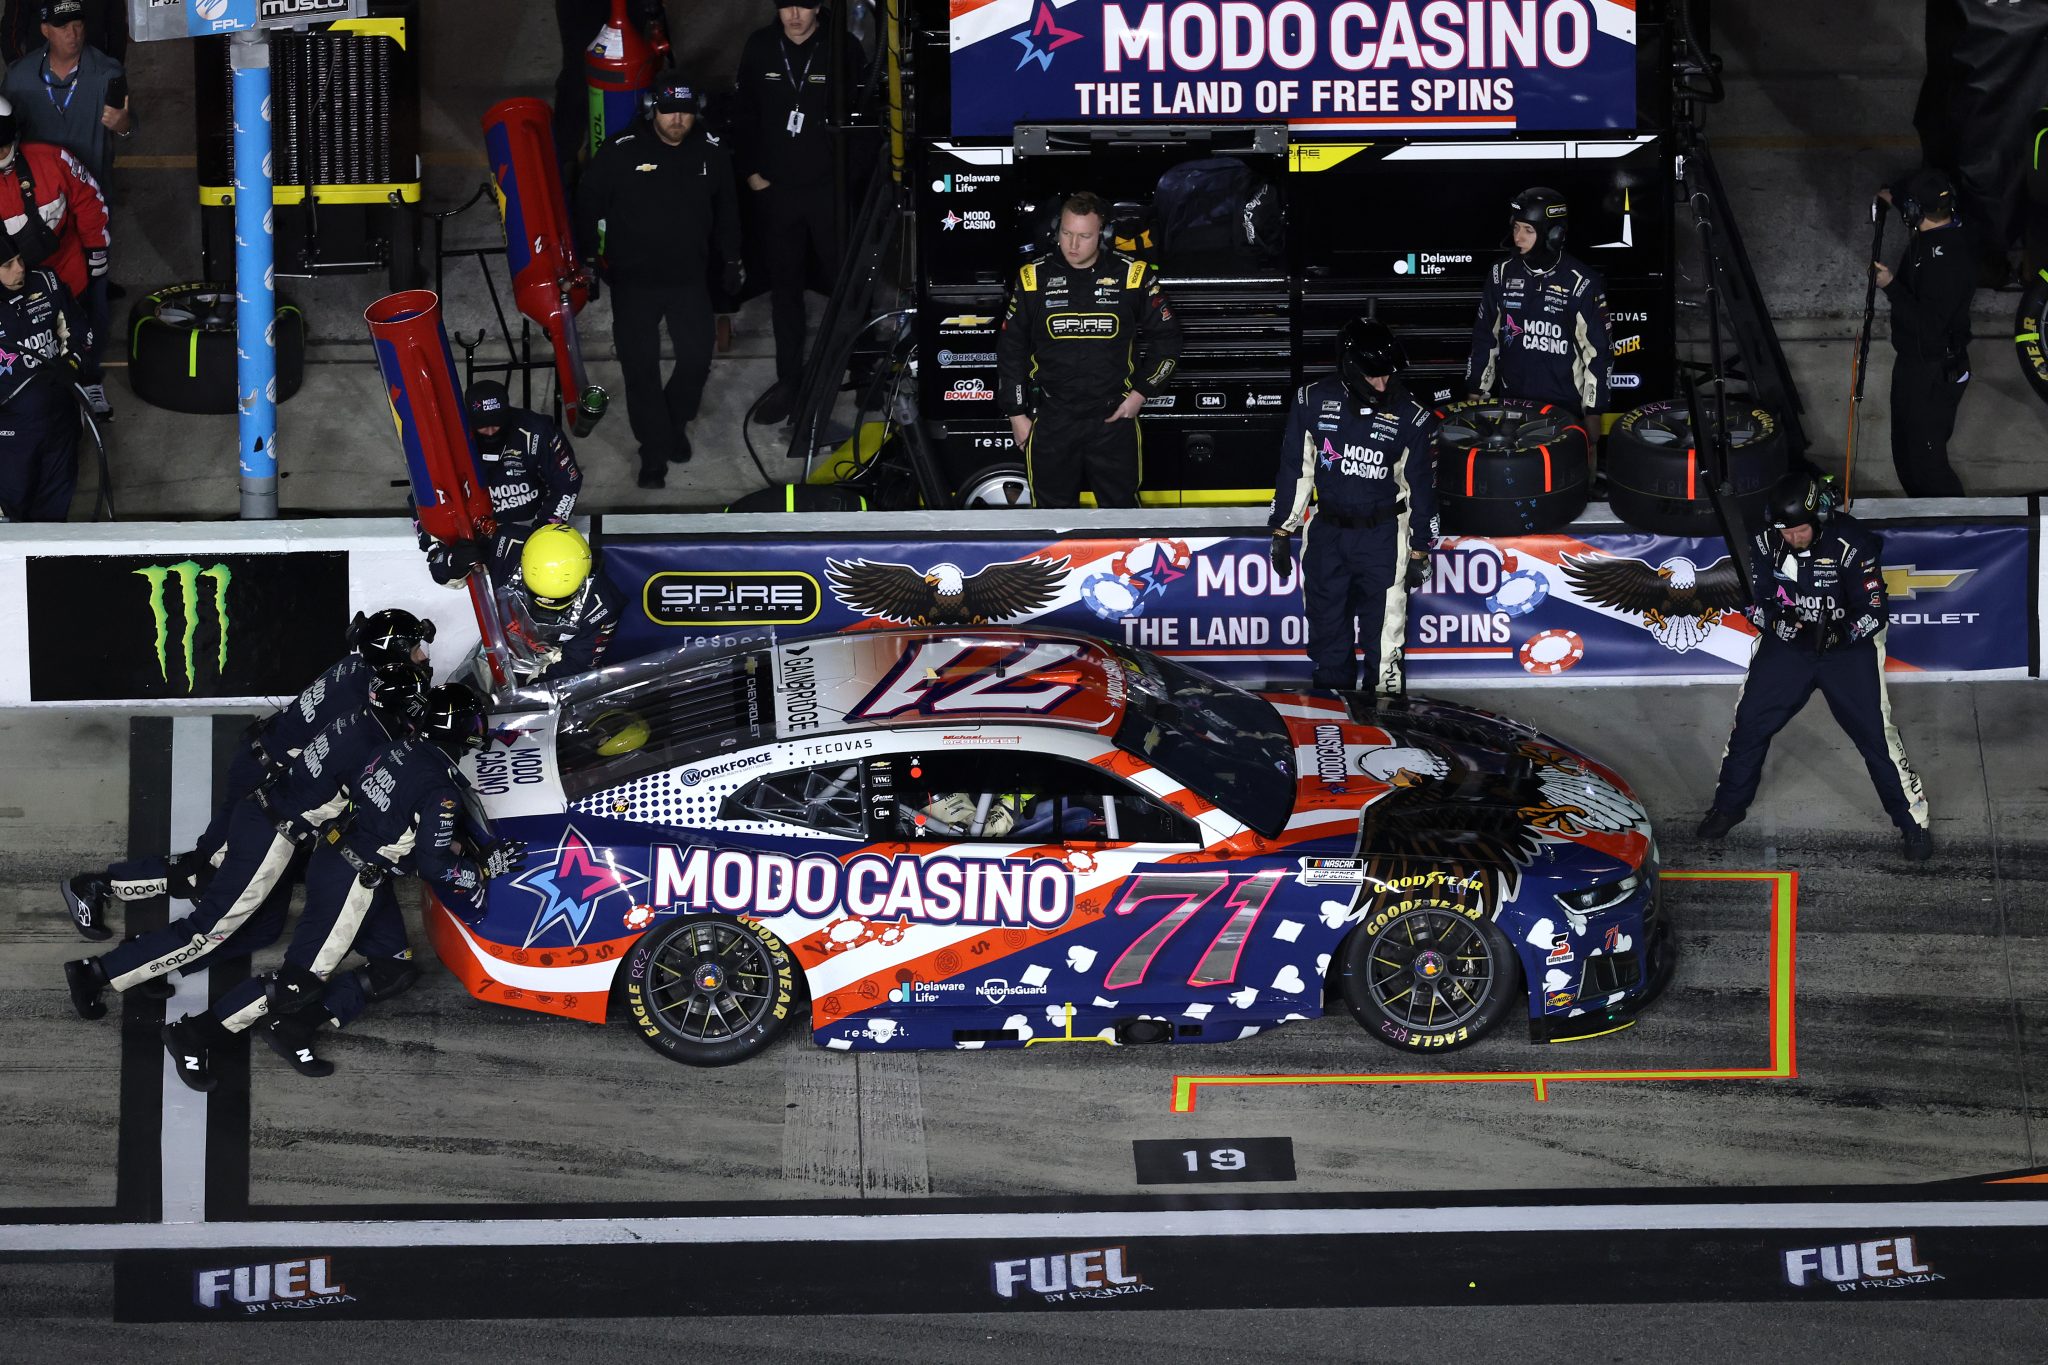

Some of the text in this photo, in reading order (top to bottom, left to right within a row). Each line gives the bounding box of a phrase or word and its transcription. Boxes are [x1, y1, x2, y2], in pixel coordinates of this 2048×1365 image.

[212, 19, 245, 31] FPL
[1103, 0, 1592, 72] MODO CASINO
[1075, 77, 1514, 115] THE LAND OF FREE SPINS
[1288, 149, 1320, 157] PIRE
[955, 173, 1001, 183] Delaware
[963, 211, 991, 220] MODO
[963, 220, 996, 230] CASINO
[1420, 253, 1473, 263] Delaware
[1052, 318, 1113, 331] SPIRE
[1609, 312, 1648, 322] COVAS
[1523, 318, 1562, 339] MODO
[1522, 334, 1569, 356] CASINO
[1613, 334, 1641, 357] STER
[955, 381, 975, 391] GO
[1611, 376, 1637, 386] UNK
[945, 391, 993, 400] BOWLING
[1201, 396, 1221, 406] SEM
[1433, 388, 1451, 399] WIX
[1446, 397, 1499, 412] EAGLE
[1620, 408, 1644, 432] EAGLE
[974, 436, 1014, 450] resp
[1343, 443, 1384, 466] MODO
[1340, 458, 1389, 480] CASINO
[488, 482, 530, 500] MODO
[491, 488, 539, 514] CASINO
[553, 494, 572, 518] MODO
[561, 493, 578, 521] CASINO
[1197, 553, 1304, 597] MOD
[661, 582, 803, 605] SPIRE
[588, 608, 609, 625] sparco
[661, 605, 803, 613] MOTORSPORTS
[1889, 612, 1980, 625] ROLET
[1120, 617, 1164, 646] THE
[1189, 615, 1260, 646] LAND
[1418, 612, 1511, 644] SPINS
[683, 630, 778, 649] respt
[783, 657, 819, 733] GAINBRIDGE
[745, 677, 761, 739] CHEVROLET
[804, 738, 874, 757] TECOVAS
[475, 749, 510, 796] CASINO
[509, 747, 545, 785] MODO
[686, 751, 773, 783] WORKFORCE
[372, 765, 397, 795] MODO
[360, 776, 391, 813] CASINO
[878, 809, 890, 817] SEM
[1324, 859, 1356, 868] NASCAR
[655, 846, 1068, 926] MODO CASINO
[1373, 870, 1484, 894] GOODYEAR
[1366, 898, 1484, 936] GOODYEAR
[1104, 868, 1288, 990] 71
[1604, 923, 1619, 951] 71
[149, 934, 210, 974] modo.us
[631, 948, 651, 980] RR-2
[737, 915, 794, 1021] GOODYEAR
[915, 981, 966, 992] Delaware
[915, 992, 936, 1003] Life
[975, 984, 1048, 997] NationsGuard
[628, 983, 661, 1038] EAGLE
[844, 1025, 910, 1040] respect.
[1380, 1020, 1409, 1042] RF-2
[1408, 1026, 1469, 1047] EAGLE
[1182, 1148, 1247, 1173] 19
[994, 1246, 1138, 1298] FUEL
[1785, 1236, 1929, 1287] FUEL
[199, 1256, 342, 1308] FUEL
[1044, 1283, 1155, 1303] BY FRANZIA
[1836, 1272, 1946, 1293] BY FRANZIA
[246, 1293, 357, 1314] BY FRANZIA
